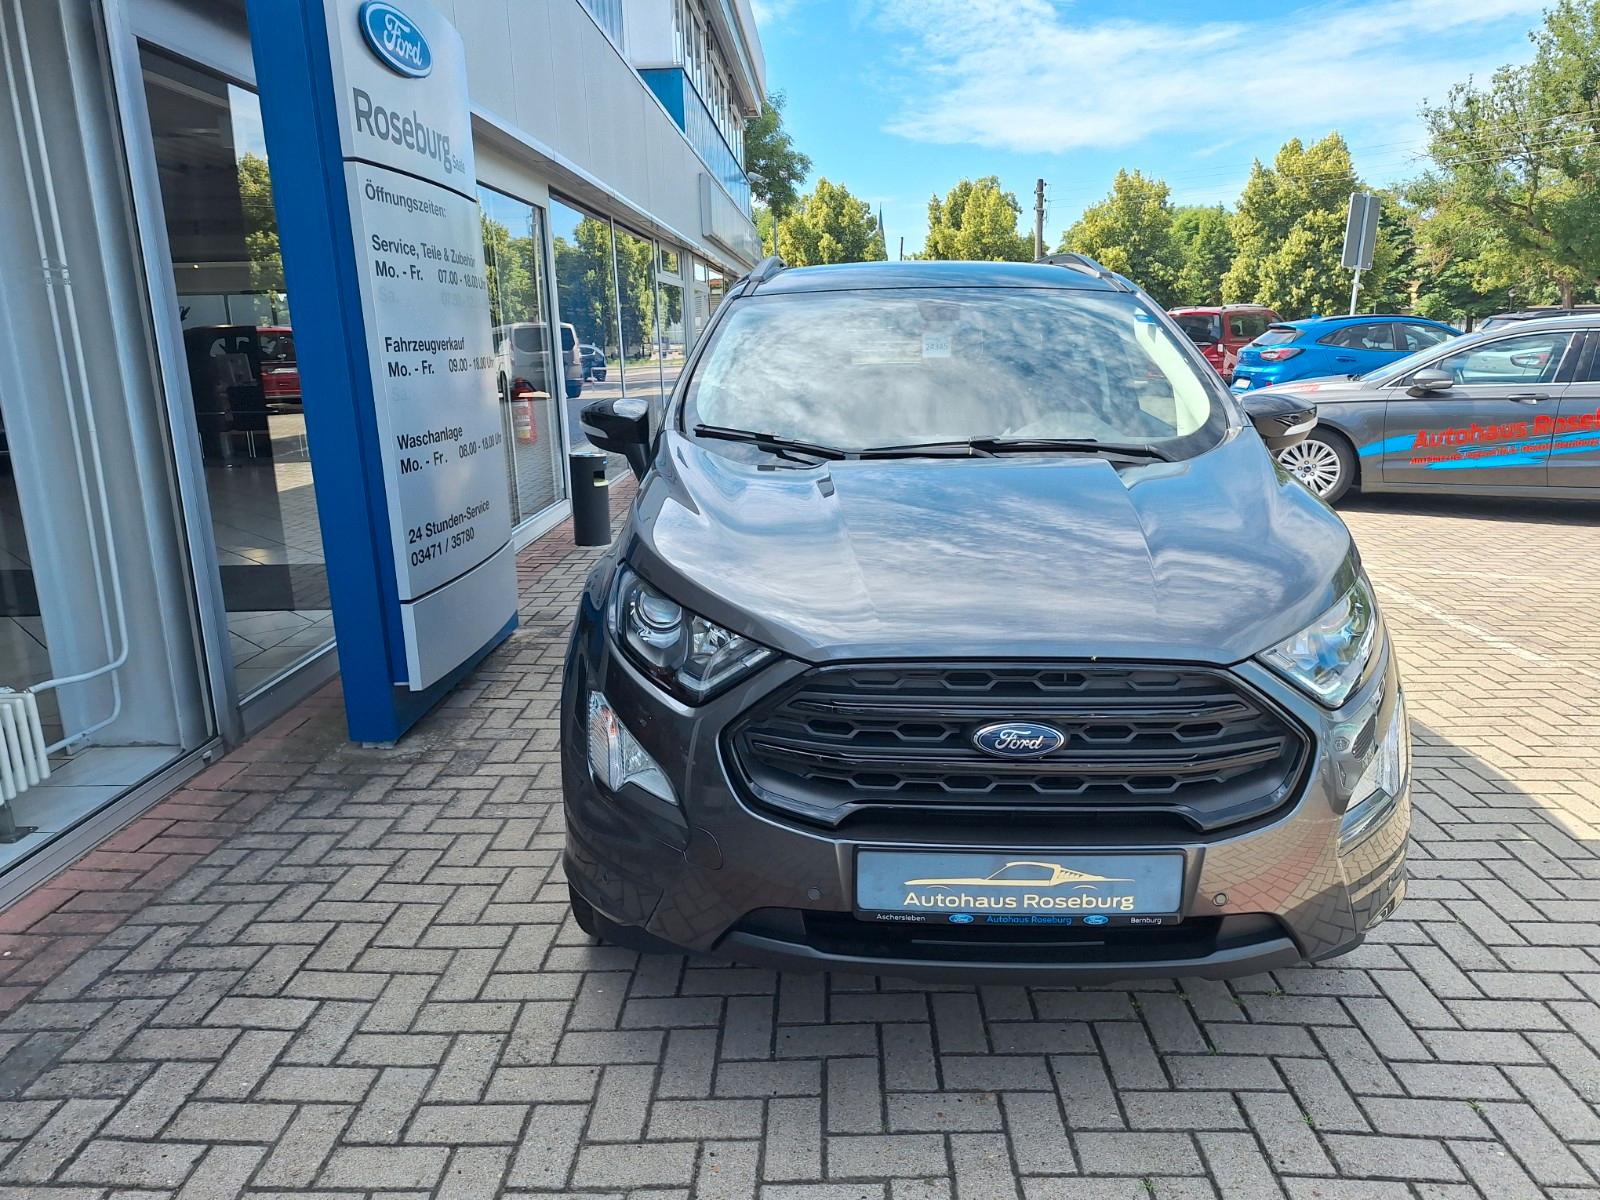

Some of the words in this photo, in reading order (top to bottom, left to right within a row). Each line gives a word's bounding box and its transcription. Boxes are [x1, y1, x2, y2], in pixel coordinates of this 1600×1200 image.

[384, 13, 423, 66] Ford
[353, 87, 452, 174] Roseburg
[365, 179, 447, 218] Öffnungszeiten:
[371, 234, 420, 260] Service,
[421, 242, 442, 261] Teile
[443, 248, 450, 262] &
[375, 260, 400, 279] Mo.
[410, 264, 424, 281] Fr.
[438, 269, 459, 286] 07.00
[385, 336, 465, 355] Fahrzeugverkauf
[387, 361, 411, 378] Mo.
[421, 360, 435, 375] Fr.
[448, 358, 468, 373] 09.00
[397, 425, 463, 450] Waschanlage
[1411, 420, 1529, 450] Autohaus
[400, 457, 423, 475] Mo.
[433, 450, 448, 467] Fr.
[459, 441, 477, 459] 08.00
[408, 527, 423, 545] 24
[425, 499, 490, 538] Stunden-Service
[411, 541, 443, 567] 03471
[451, 527, 475, 550] 35780
[995, 729, 1044, 750] Ford
[903, 891, 1018, 908] Autohaus
[1023, 892, 1135, 911] Roseburg
[876, 913, 926, 922] Aschersleben
[986, 915, 1029, 924] Autohaus
[1031, 916, 1073, 926] Roseburg
[1130, 917, 1162, 925] Bernburg
